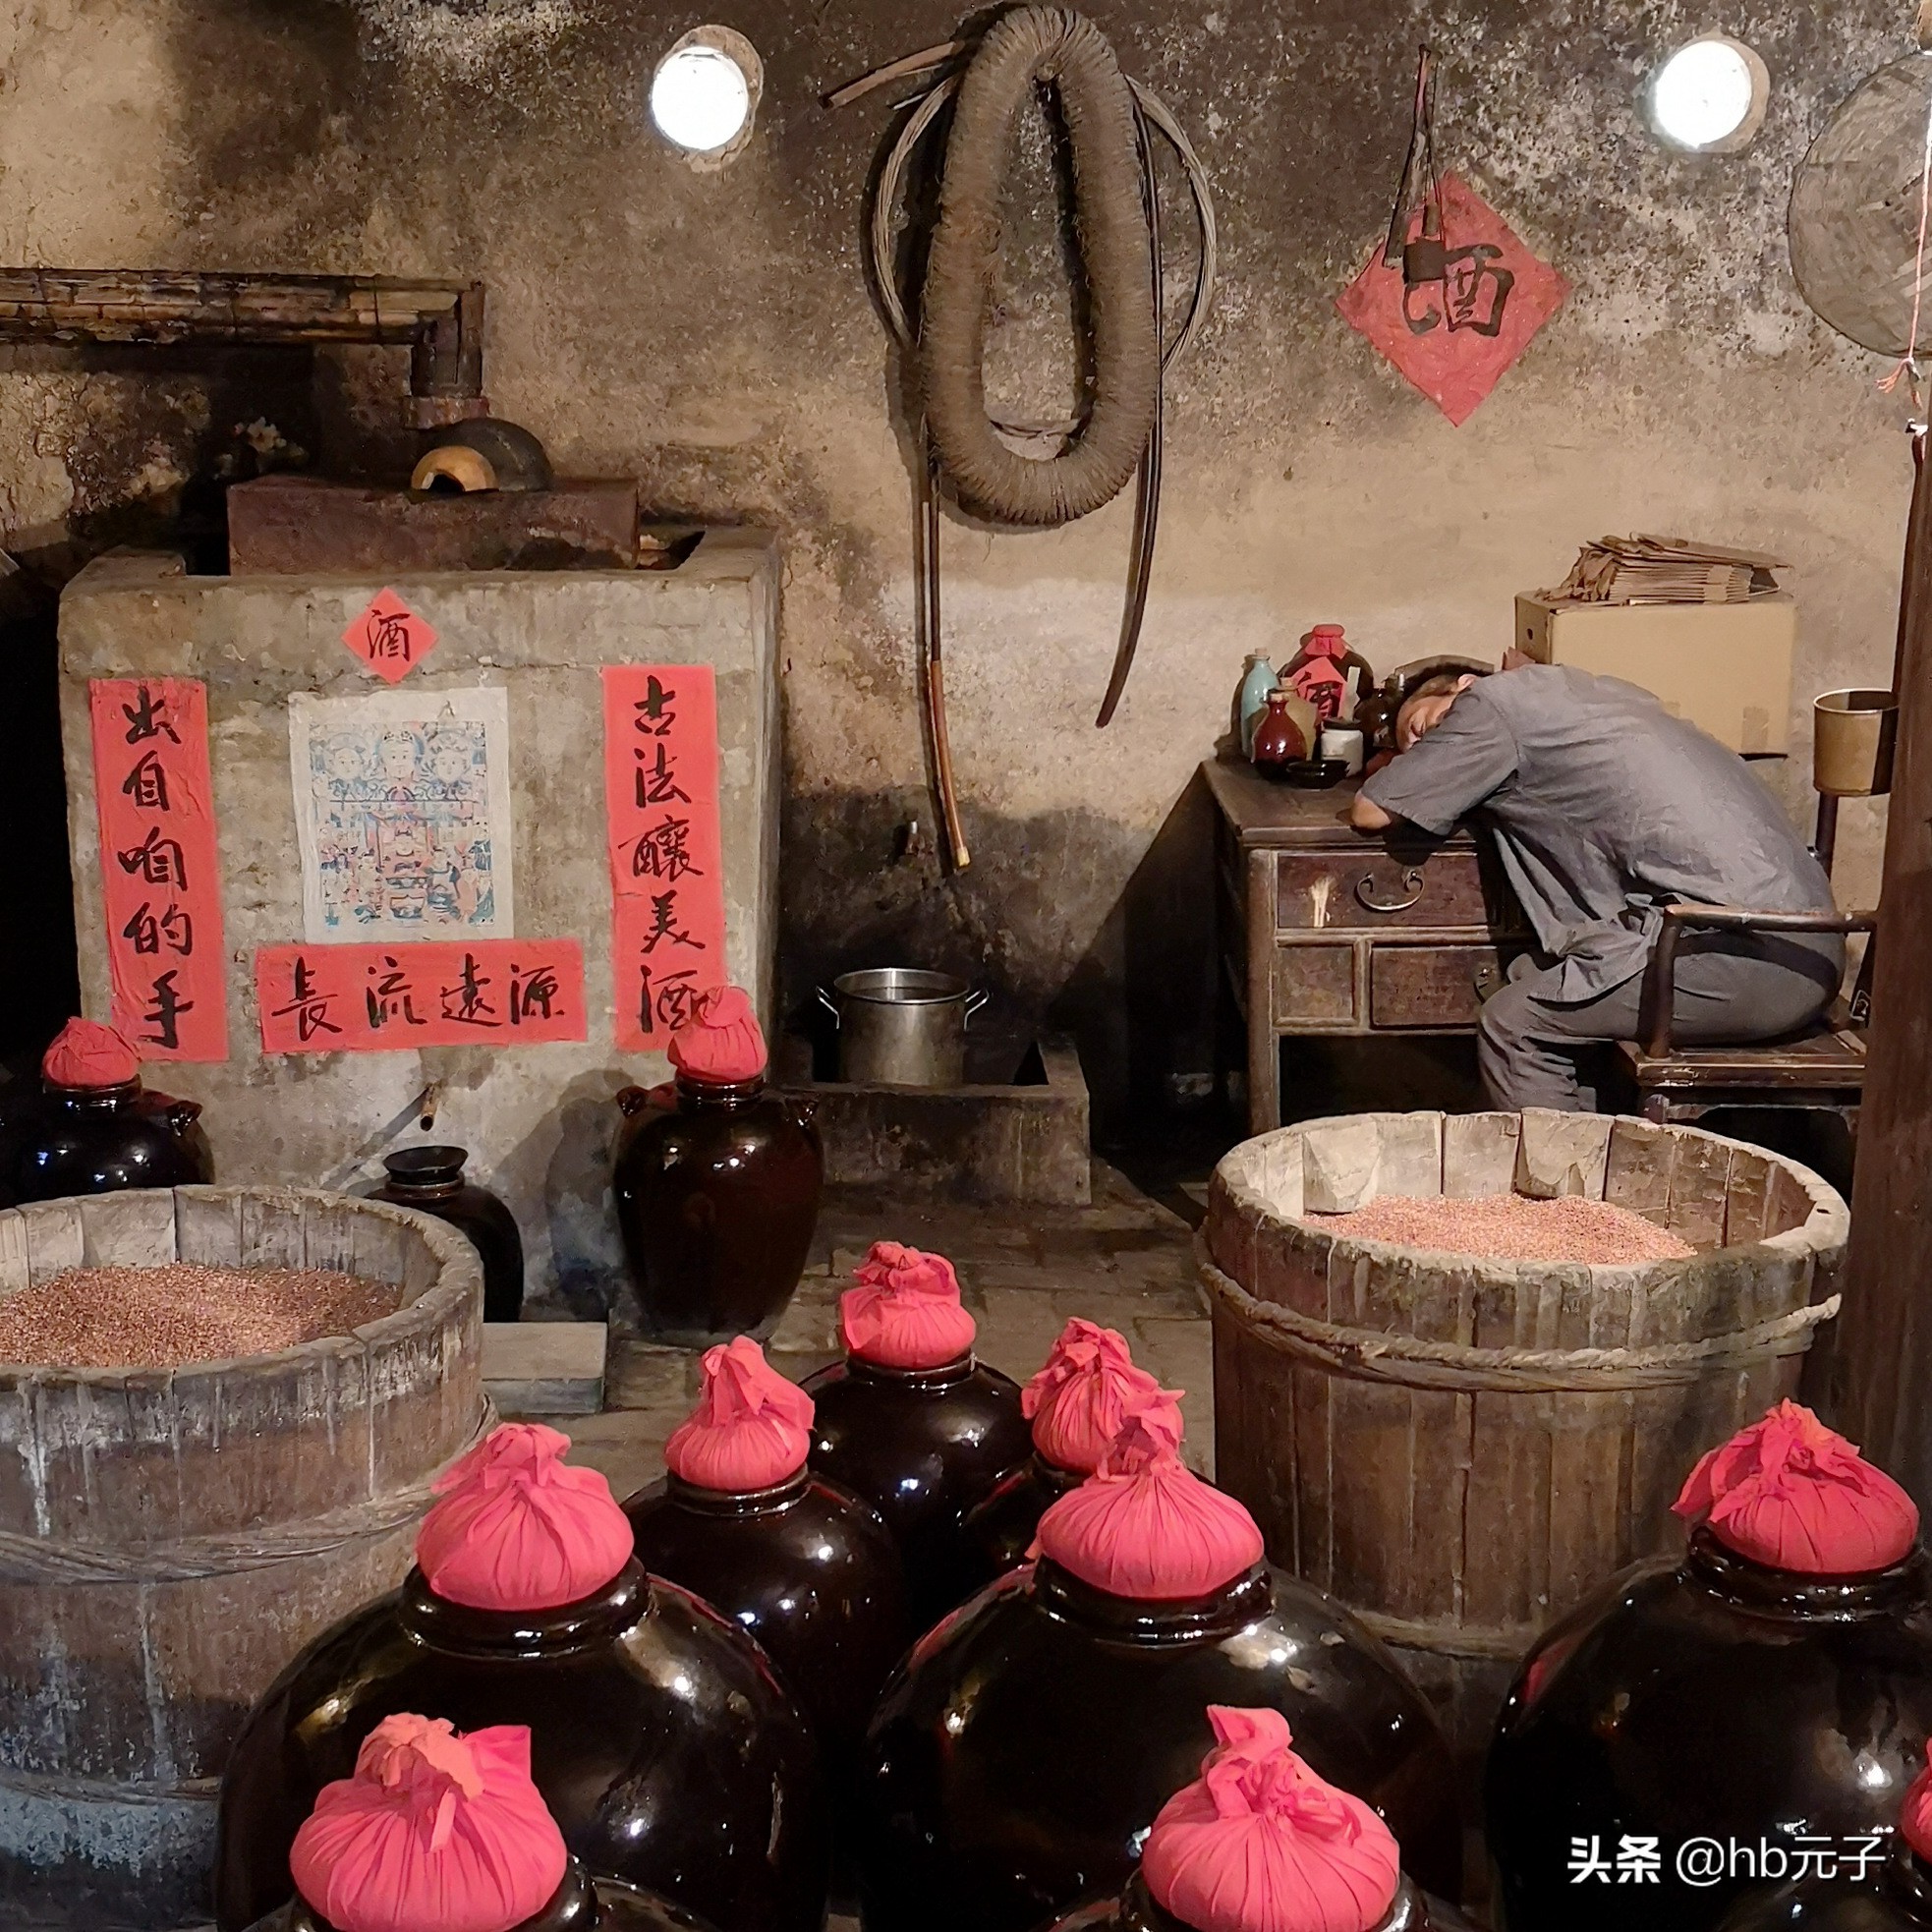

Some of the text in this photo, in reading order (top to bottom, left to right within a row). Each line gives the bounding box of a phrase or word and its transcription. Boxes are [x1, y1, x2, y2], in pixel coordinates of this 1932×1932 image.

[367, 609, 411, 662] 酒
[118, 688, 195, 1049] 出自咱的手
